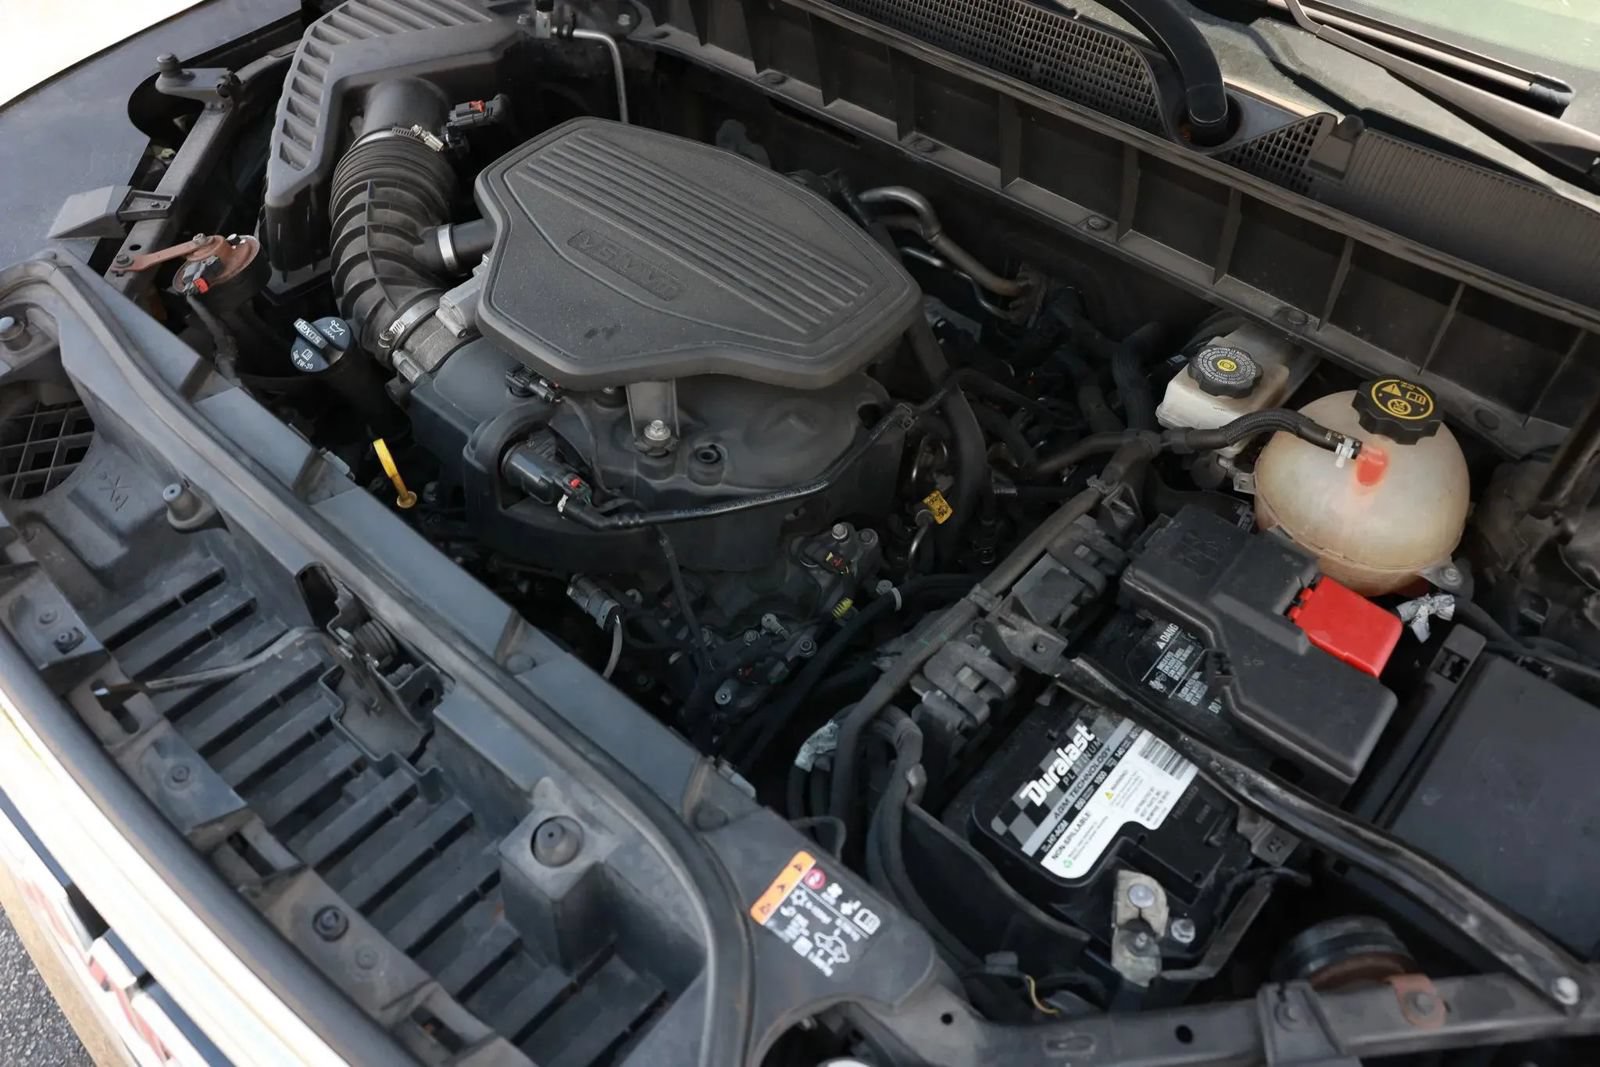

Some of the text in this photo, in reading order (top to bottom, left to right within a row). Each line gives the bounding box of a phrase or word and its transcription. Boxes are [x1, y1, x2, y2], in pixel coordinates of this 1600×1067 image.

[296, 320, 322, 345] dexos
[1019, 724, 1095, 807] Duralast
[1053, 797, 1073, 820] AGM
[1069, 746, 1112, 799] TECHNOLOGY
[1063, 737, 1104, 786] PLATINUM
